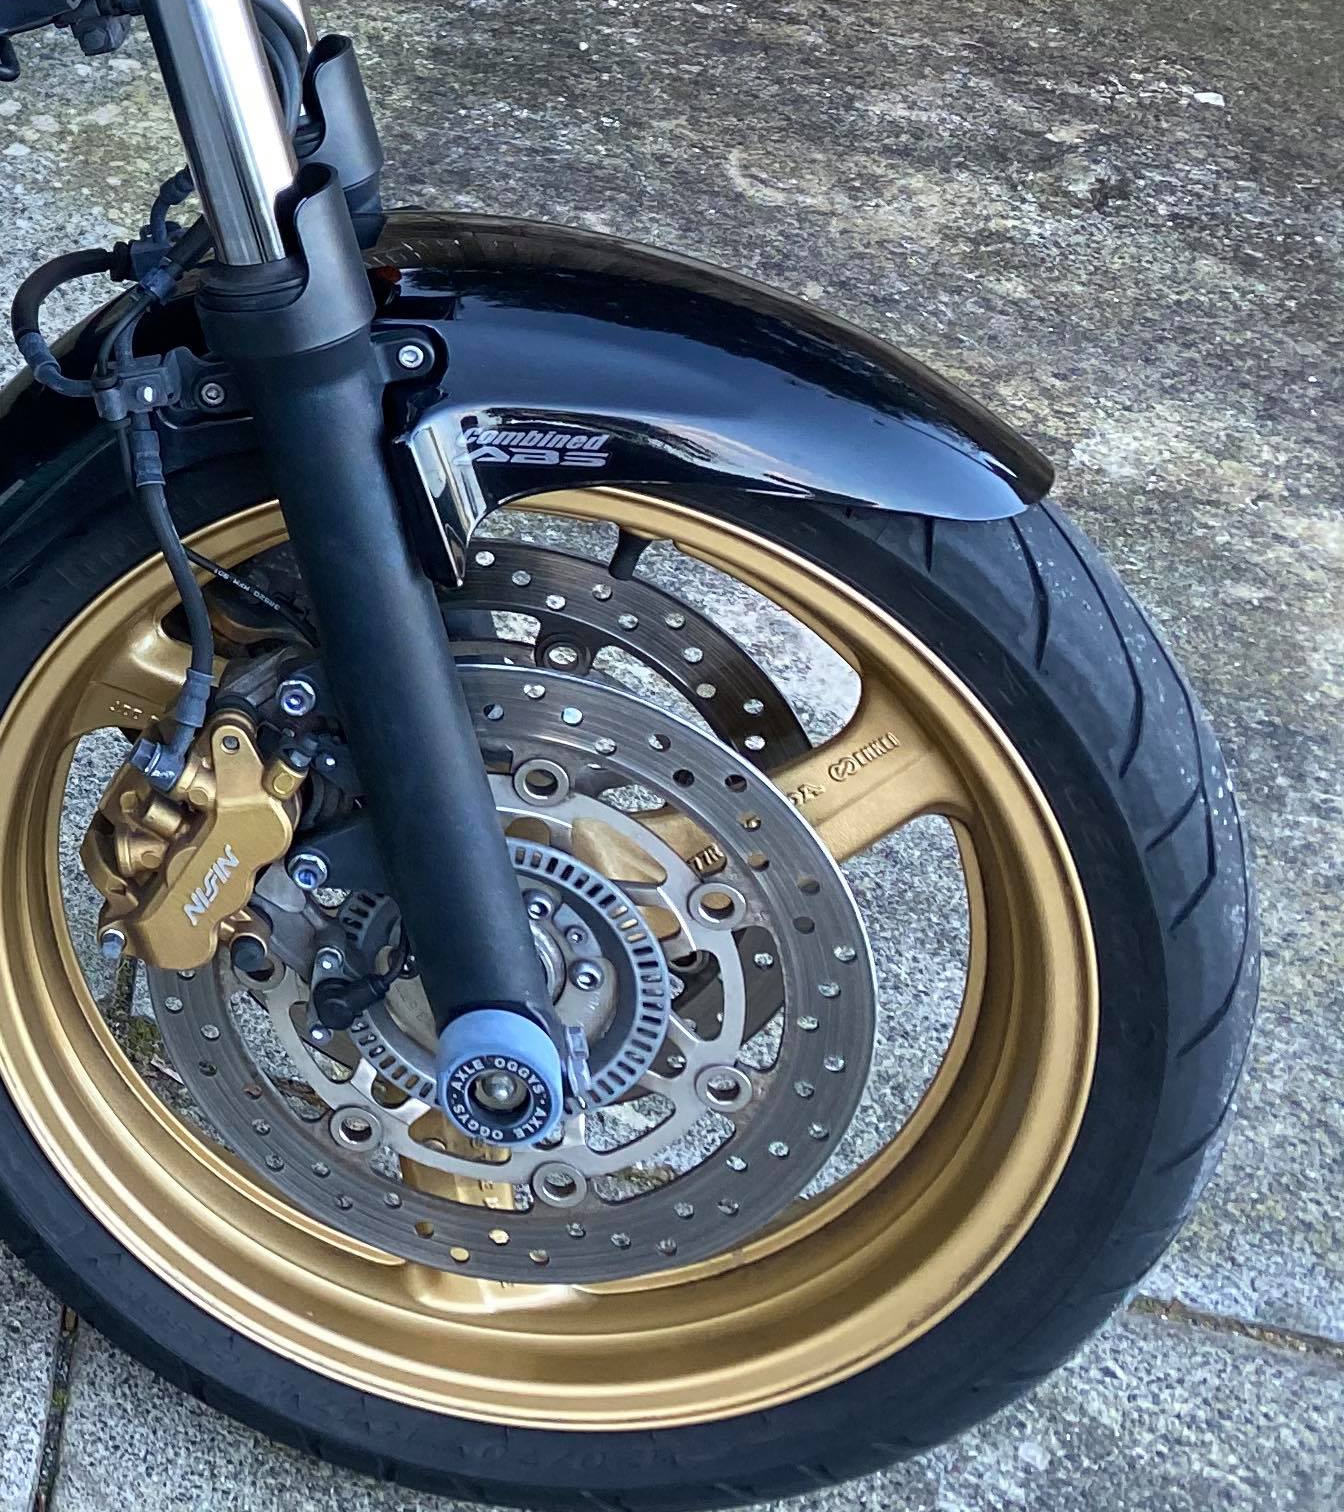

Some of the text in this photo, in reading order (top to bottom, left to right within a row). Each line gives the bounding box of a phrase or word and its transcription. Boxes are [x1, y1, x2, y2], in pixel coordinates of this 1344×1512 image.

[457, 427, 610, 451] Combined
[451, 445, 610, 468] ABS
[451, 1057, 546, 1095] AXLE OGGYS
[453, 1103, 548, 1140] AXLE OGGYS
